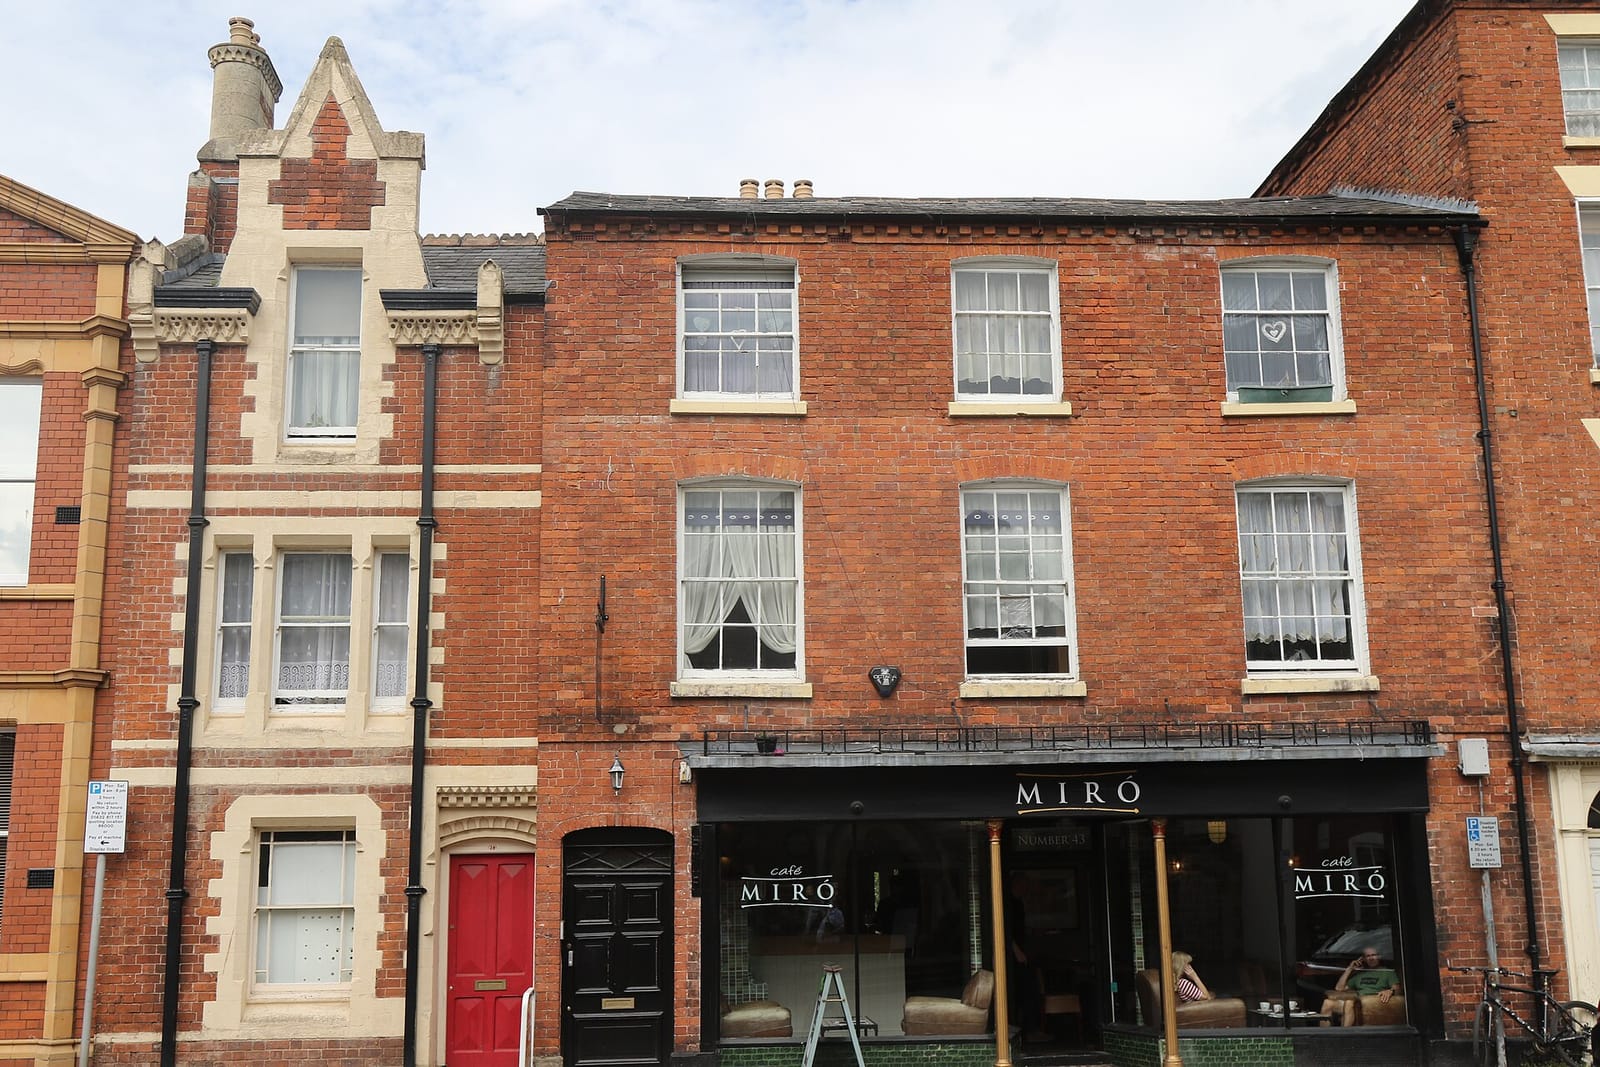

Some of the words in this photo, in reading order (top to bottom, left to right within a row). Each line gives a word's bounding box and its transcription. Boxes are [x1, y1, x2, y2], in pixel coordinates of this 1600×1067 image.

[1016, 775, 1140, 805] MIRÓ
[1018, 835, 1069, 846] NUMBER
[770, 864, 803, 876] café
[1321, 856, 1353, 867] café
[1294, 869, 1385, 892] MIRÓ
[741, 878, 835, 901] MIRÓ
